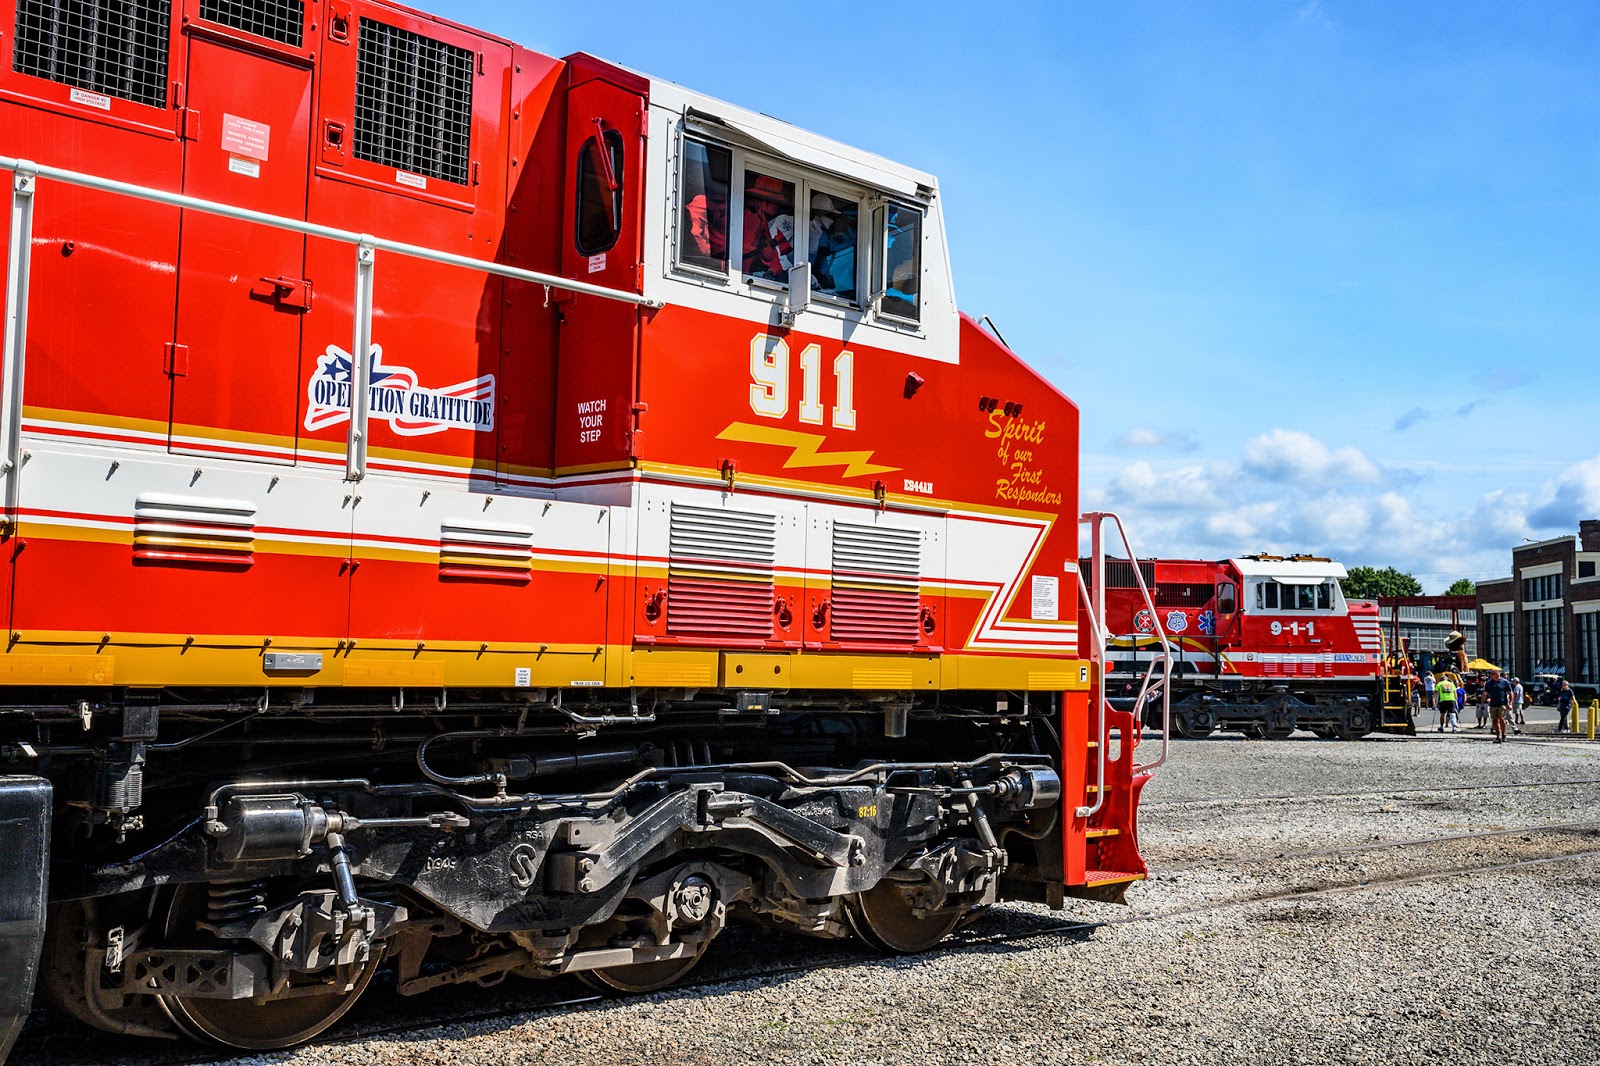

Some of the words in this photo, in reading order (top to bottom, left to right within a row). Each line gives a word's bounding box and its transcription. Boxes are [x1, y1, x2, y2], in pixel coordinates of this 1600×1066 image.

[86, 99, 106, 107] VOLTAGE
[236, 120, 257, 128] DANGER
[242, 126, 264, 135] VOLTAGE
[750, 332, 856, 431] 911
[410, 392, 491, 426] GRATITUDE
[578, 399, 607, 414] WATCH
[580, 414, 603, 428] YOUR
[984, 408, 1046, 446] Spirit
[580, 430, 601, 443] STEP
[998, 441, 1010, 465] of
[1014, 449, 1033, 462] our
[1010, 462, 1042, 485] First
[995, 479, 1062, 505] Responders
[1270, 621, 1314, 635] 9-1-1
[1080, 667, 1086, 681] F
